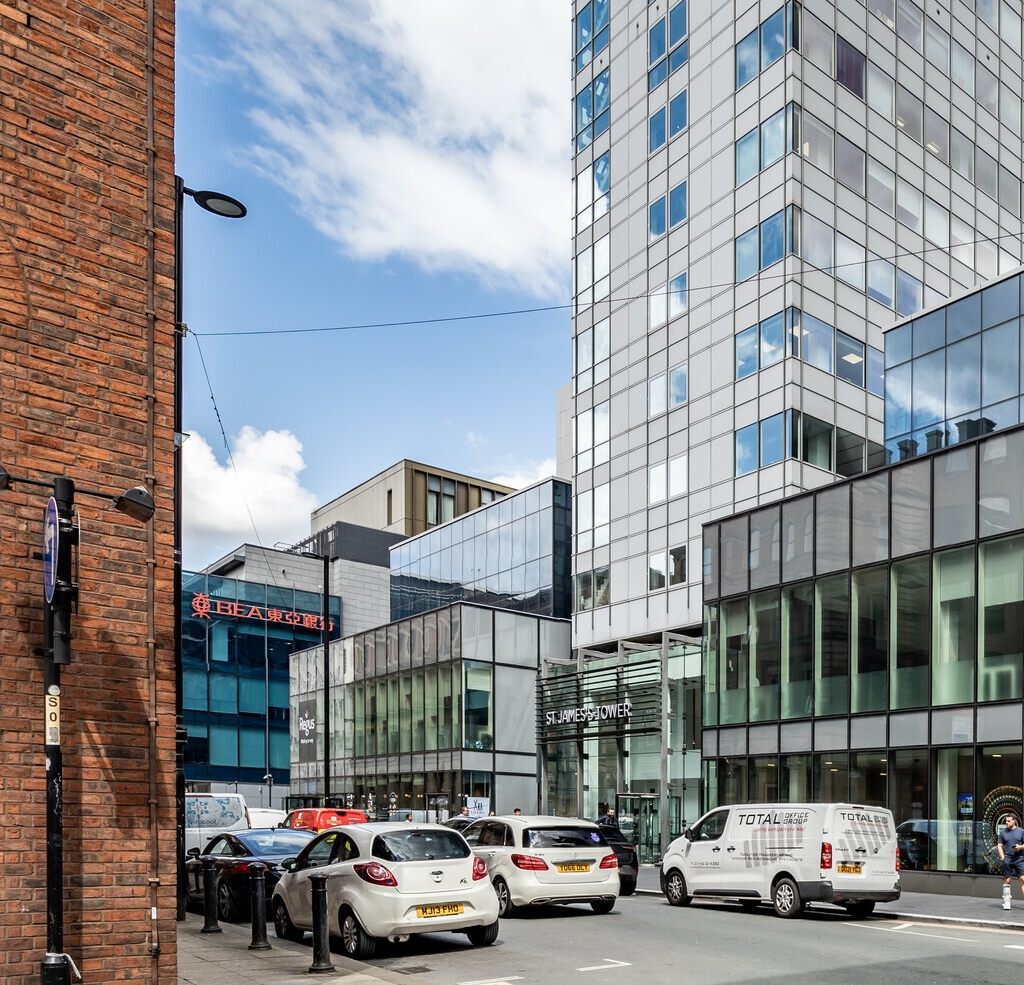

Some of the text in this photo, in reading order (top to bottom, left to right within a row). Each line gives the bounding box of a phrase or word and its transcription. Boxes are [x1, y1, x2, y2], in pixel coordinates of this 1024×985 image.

[216, 600, 264, 620] BEA
[594, 702, 632, 720] TOWER
[738, 813, 781, 825] TOTAL
[840, 812, 874, 823] TOTAL
[421, 906, 441, 916] MJ13
